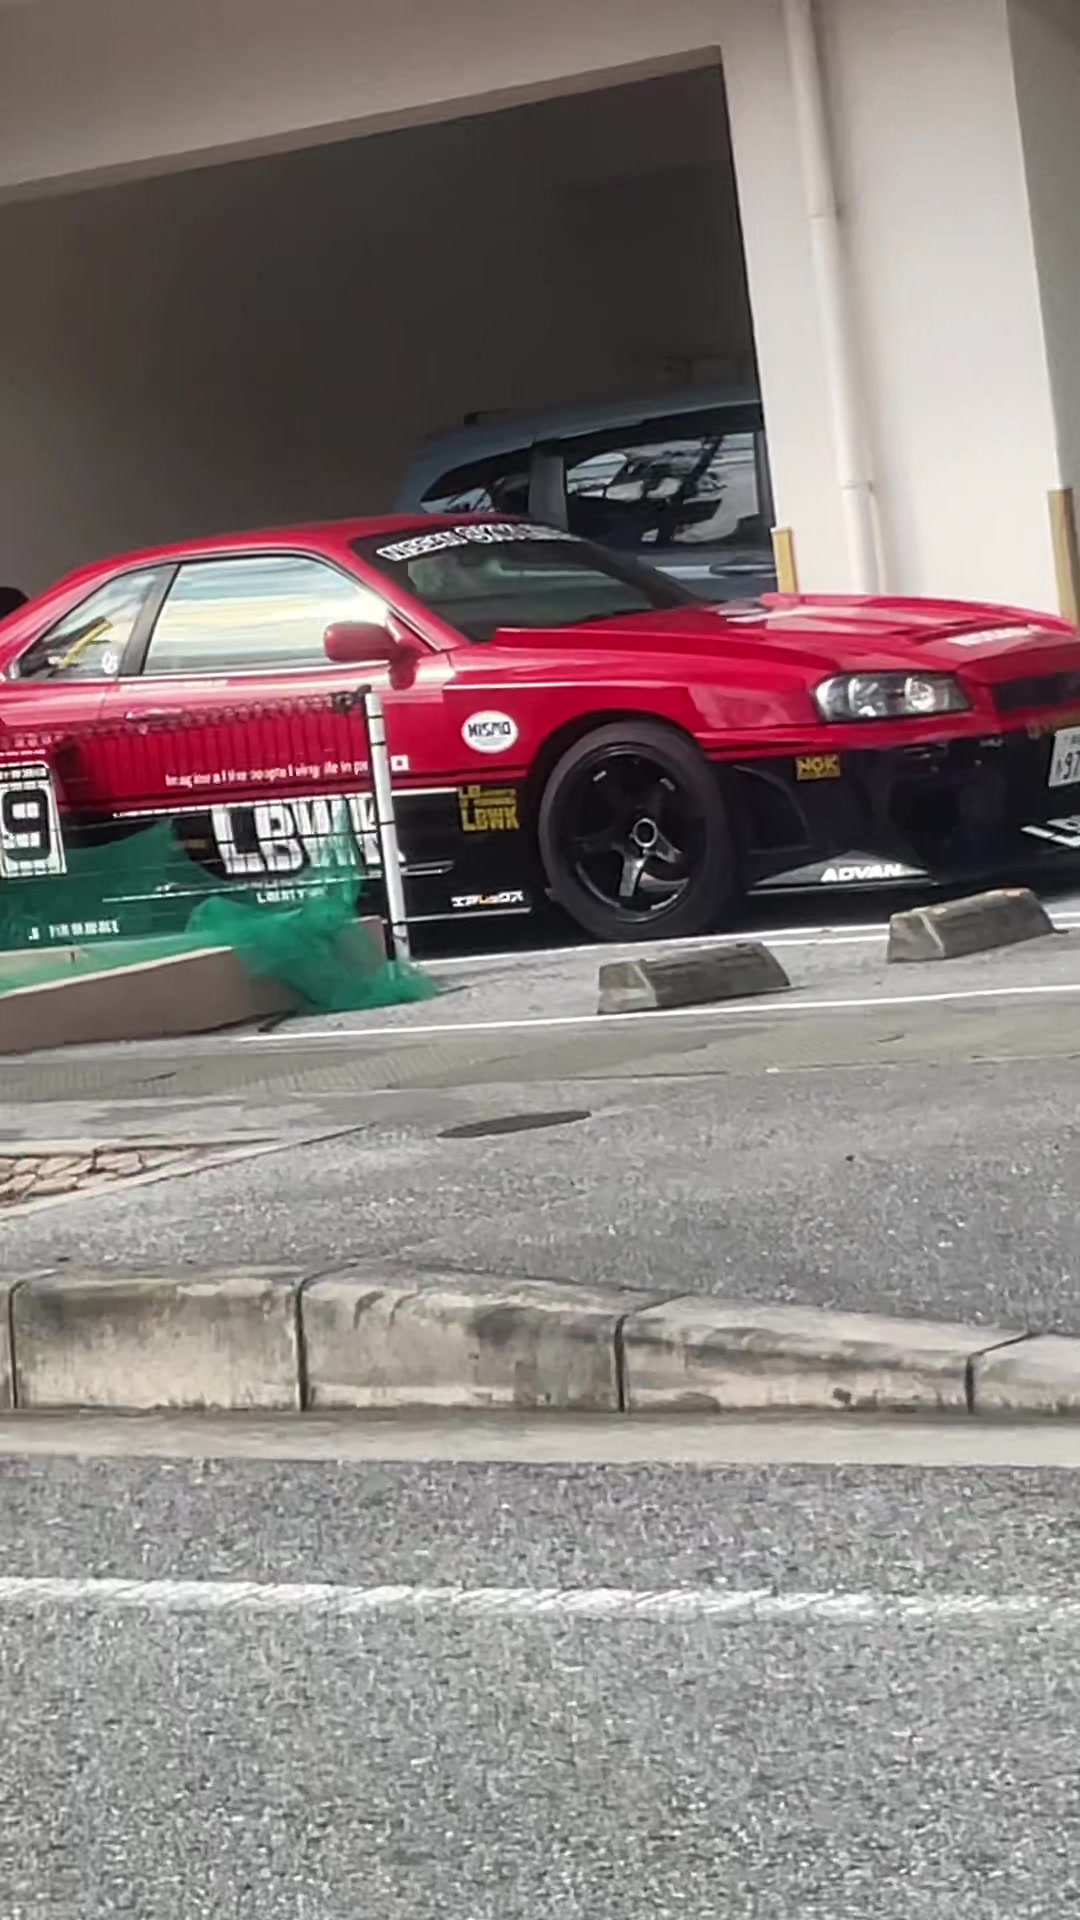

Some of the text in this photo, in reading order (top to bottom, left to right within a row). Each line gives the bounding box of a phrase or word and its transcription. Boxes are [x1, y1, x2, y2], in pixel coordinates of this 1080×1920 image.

[468, 721, 511, 738] NISMO
[461, 806, 520, 831] LBWK
[820, 863, 902, 882] ADVAN
